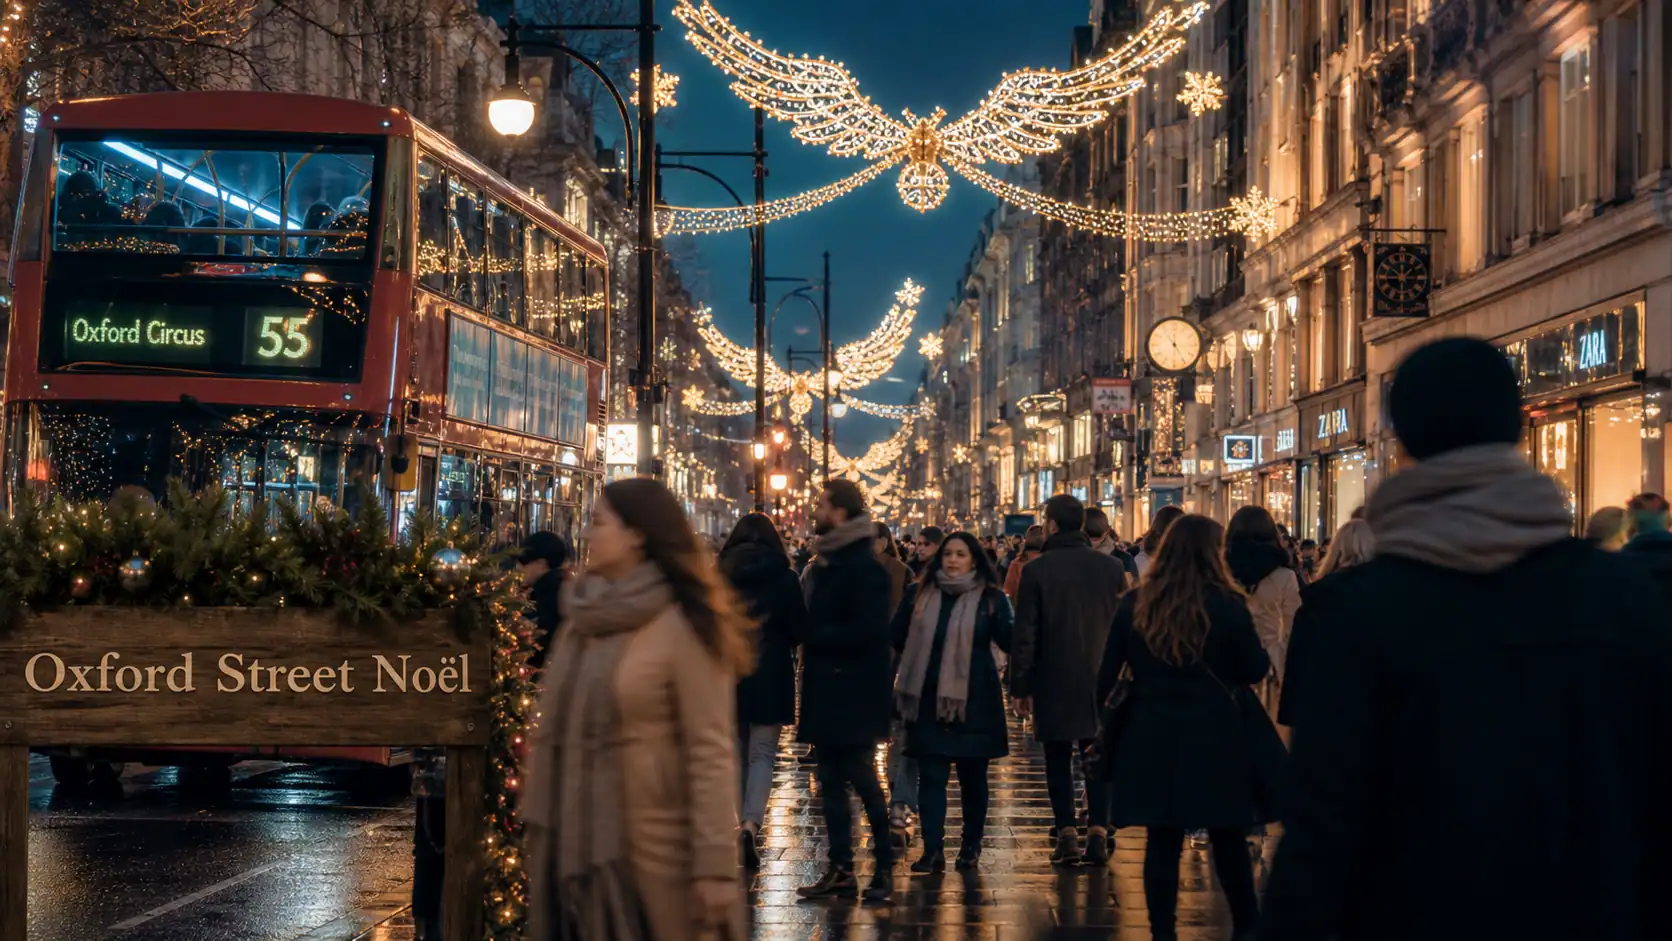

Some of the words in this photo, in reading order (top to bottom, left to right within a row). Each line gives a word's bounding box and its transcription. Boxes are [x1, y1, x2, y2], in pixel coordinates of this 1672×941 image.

[72, 317, 141, 344] Oxford
[146, 319, 206, 346] Circus
[258, 315, 311, 358] 55
[1579, 329, 1607, 369] ZARA
[24, 651, 196, 693] Oxford
[217, 653, 355, 694] Street
[372, 654, 472, 694] Noël
